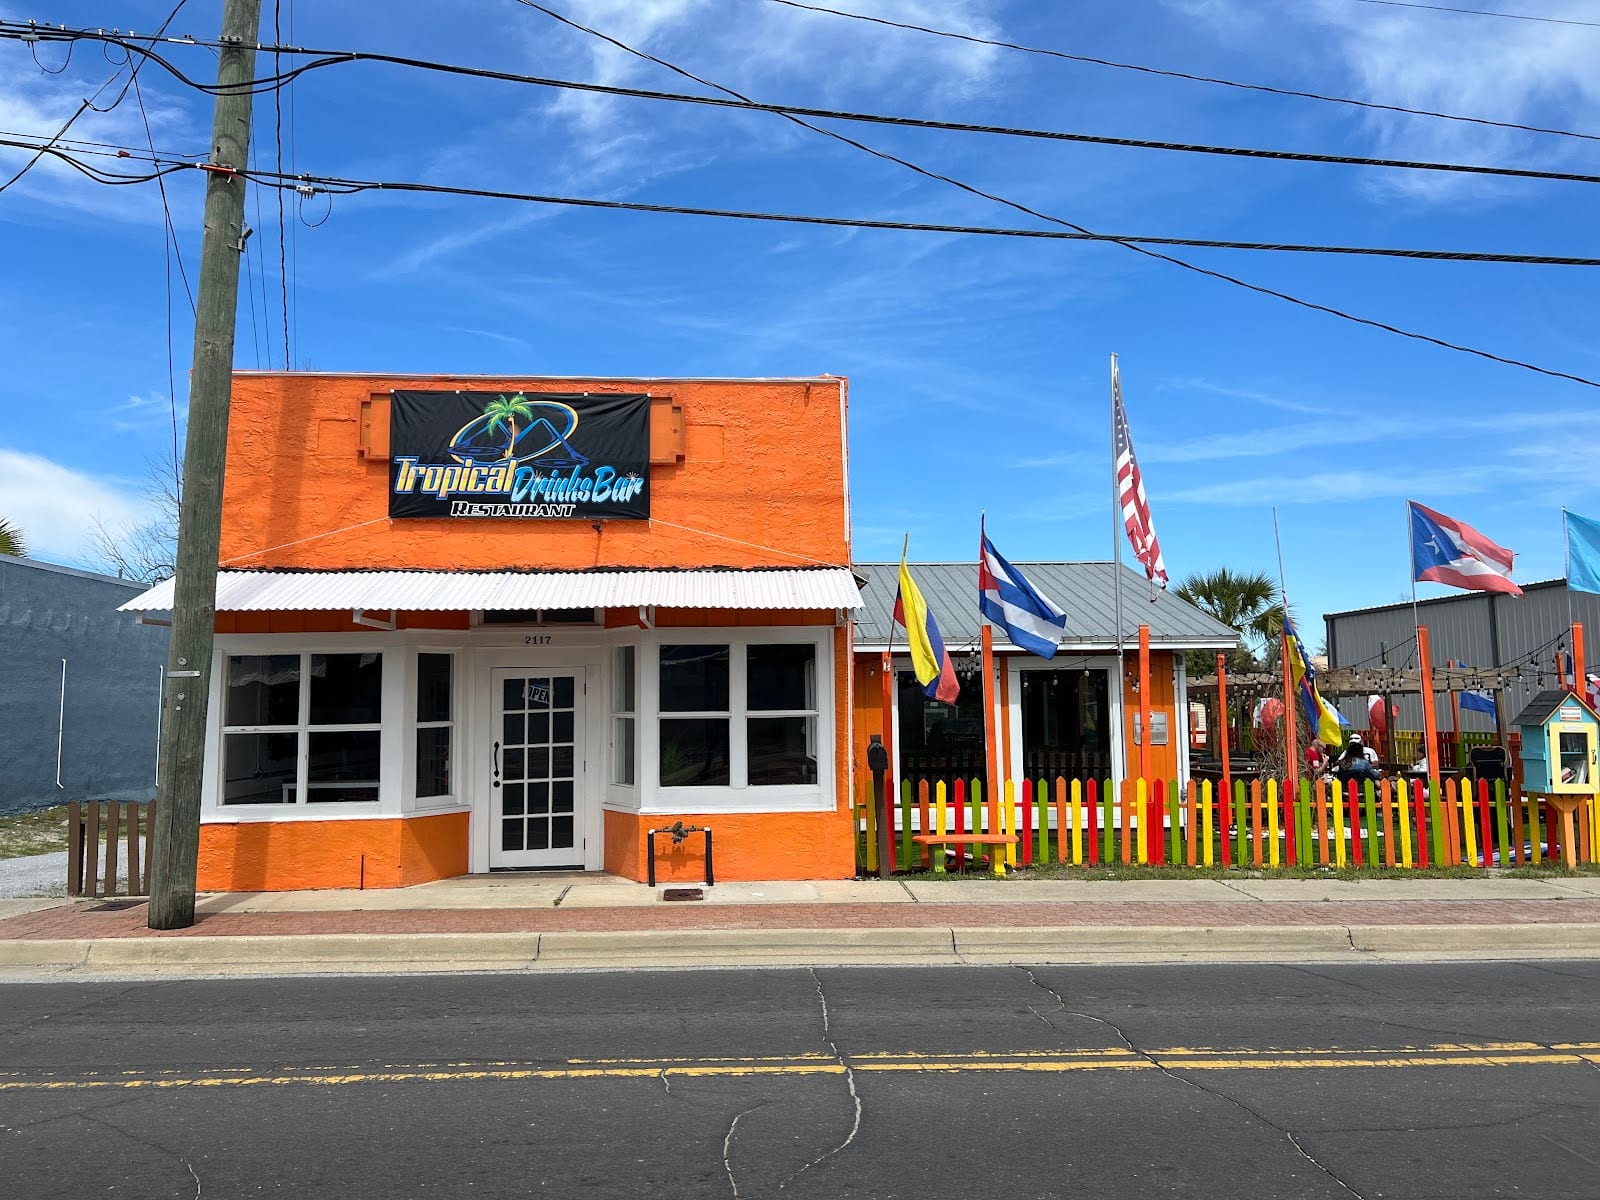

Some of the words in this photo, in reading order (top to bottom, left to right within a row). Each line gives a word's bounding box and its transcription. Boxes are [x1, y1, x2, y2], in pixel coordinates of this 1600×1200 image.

[394, 456, 519, 500] Tropical
[450, 501, 576, 517] RESTAURANT
[525, 635, 552, 645] 2117
